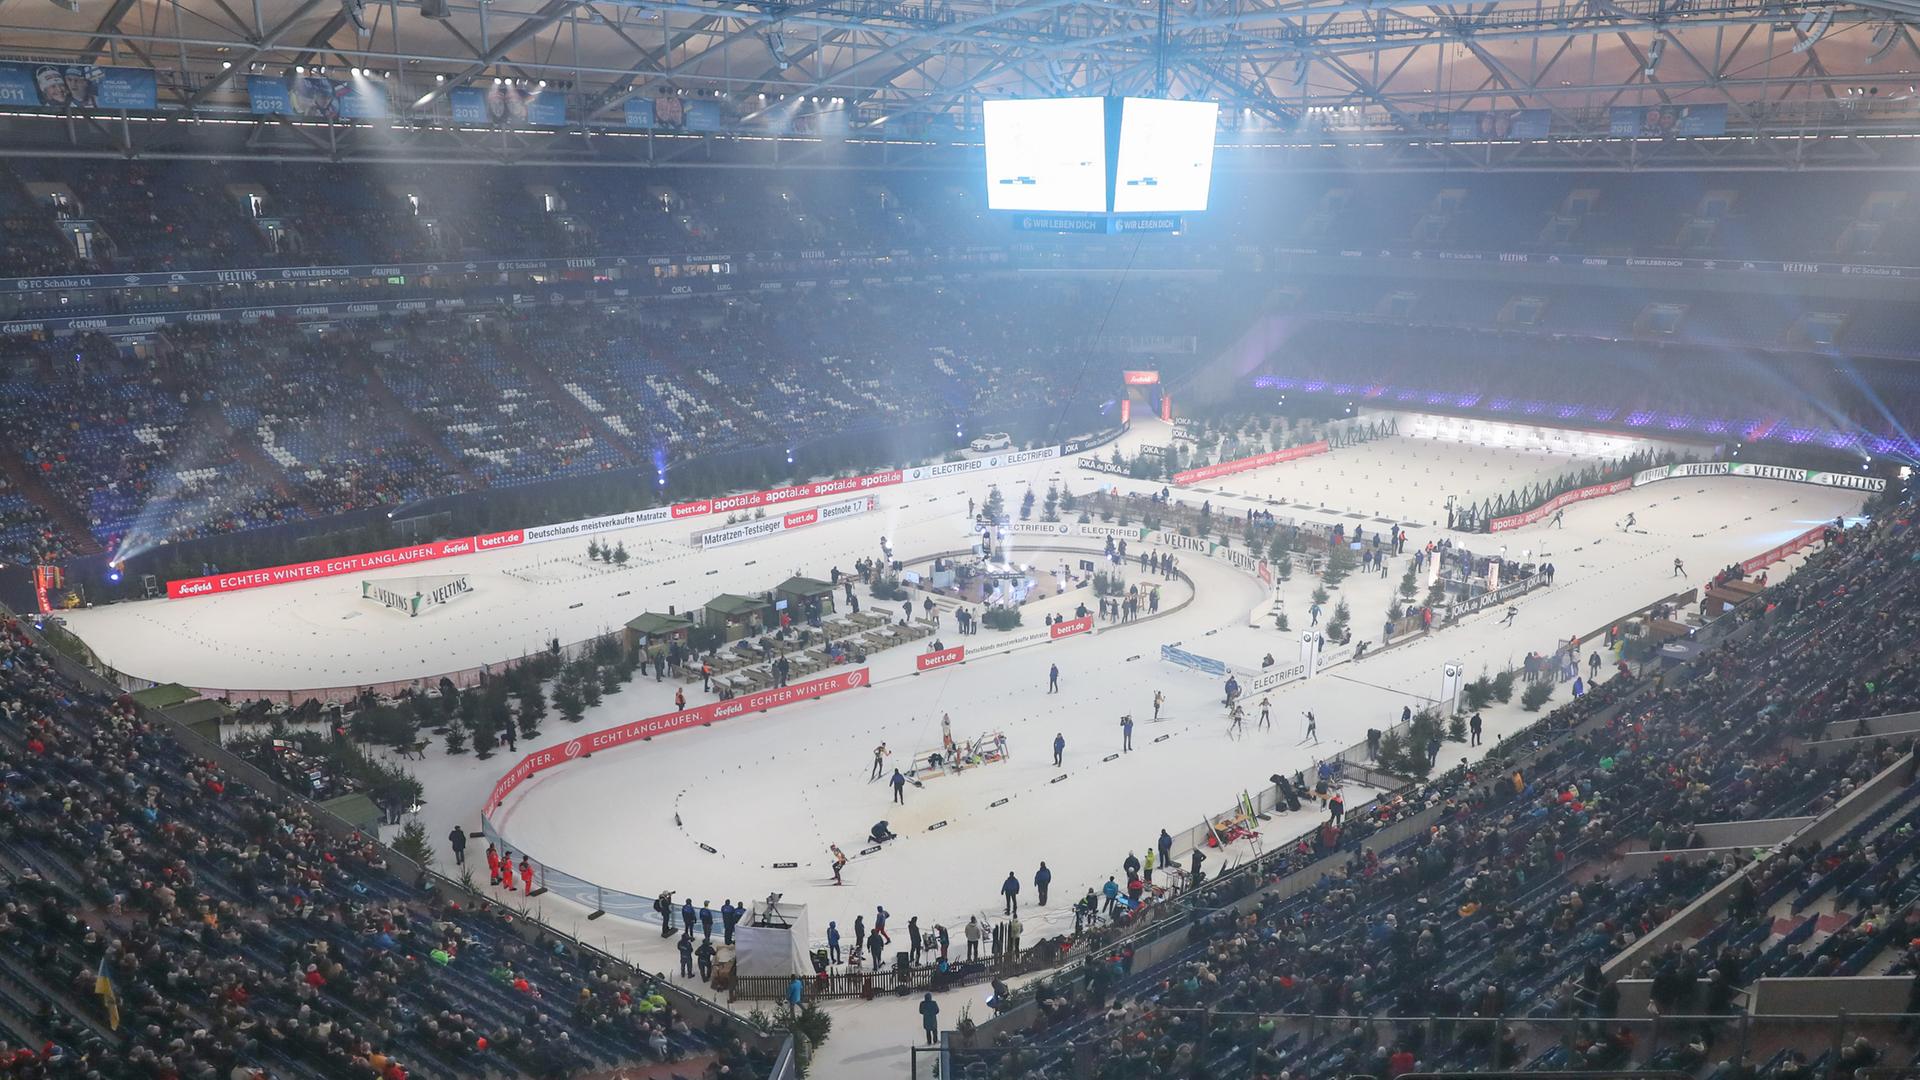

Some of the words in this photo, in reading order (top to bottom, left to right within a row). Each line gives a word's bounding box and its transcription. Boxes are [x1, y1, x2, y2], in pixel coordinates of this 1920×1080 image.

[0, 89, 24, 100] 011
[256, 100, 283, 109] 2012
[455, 109, 481, 118] 2013
[1033, 220, 1048, 228] WIR
[1049, 220, 1074, 229] LEBEN
[1075, 221, 1096, 230] DICH
[1124, 220, 1138, 229] WIR
[1138, 220, 1157, 228] LEBEN
[1158, 219, 1174, 228] DICH
[566, 258, 597, 268] VELTINS
[1499, 253, 1528, 263] VELTINS
[291, 270, 306, 278] WIR
[307, 269, 331, 278] LEBEN
[331, 269, 350, 277] DICH
[1783, 263, 1819, 273] VELTINS
[1852, 266, 1861, 274] FC
[1862, 267, 1890, 276] Schalke
[30, 279, 42, 288] FC
[44, 278, 78, 288] Schalke
[80, 277, 92, 287] 04
[217, 270, 258, 282] VELTINS
[671, 286, 692, 294] ORCA
[1065, 443, 1079, 453] JOKA
[931, 460, 982, 475] ELECTRIFIED
[1007, 449, 1053, 463] ELECTRIFIED
[1078, 458, 1104, 470] JOKA.de
[1104, 463, 1130, 476] JOKA.de
[1685, 463, 1729, 475] VELTINS
[1753, 465, 1805, 480] VELTINS
[1831, 474, 1885, 490] VELTINS
[714, 494, 761, 511] apotal.de
[766, 486, 810, 502] apotal.de
[814, 480, 857, 495] apotal.de
[860, 472, 901, 487] apotal.de
[1581, 486, 1607, 499] apotal.de
[675, 503, 707, 515] bett1.de
[822, 504, 851, 518] Bestnote
[853, 501, 862, 512] 1,7
[528, 525, 579, 540] Deutschlands
[580, 513, 635, 532] meistverkaufte
[636, 509, 667, 523] Matratze
[787, 513, 814, 526] bett1.de
[1493, 516, 1524, 530] apotal.de
[703, 520, 781, 545] Matratzen-Testsieger
[1008, 523, 1055, 533] ECTRIFIED
[1081, 526, 1139, 538] ELECTRIFIED
[481, 533, 519, 546] bett1.de
[1164, 533, 1205, 552] VELTINS
[1227, 549, 1256, 571] VELTINS
[178, 582, 213, 595] Seefeld
[219, 573, 270, 589] ECHTER
[273, 566, 324, 581] WINTER.
[326, 559, 357, 573] ECHT
[361, 547, 437, 568] LANGLAUFEN.
[442, 543, 469, 555] Seefeld
[431, 577, 468, 604] VELTINS
[378, 587, 408, 611] VELTINS
[1451, 602, 1478, 619] JOKA.de
[1479, 593, 1498, 609] JOKA
[1057, 622, 1085, 635] bett1.de
[965, 644, 996, 660] Deutschlands
[996, 636, 1029, 653] meistverkaufte
[1029, 631, 1049, 643] Matratze
[924, 652, 957, 666] bett1.de
[1327, 649, 1350, 662] ELECTRIFIED
[1253, 664, 1306, 690] ELECTRIFIED
[494, 774, 516, 801] ECHTER
[516, 754, 555, 779] WINTER.
[593, 731, 624, 747] ECHT
[626, 711, 704, 737] LANGLAUFEN.
[713, 703, 743, 718] Seefeld
[750, 690, 793, 708] ECHTER
[796, 680, 840, 698] WINTER.
